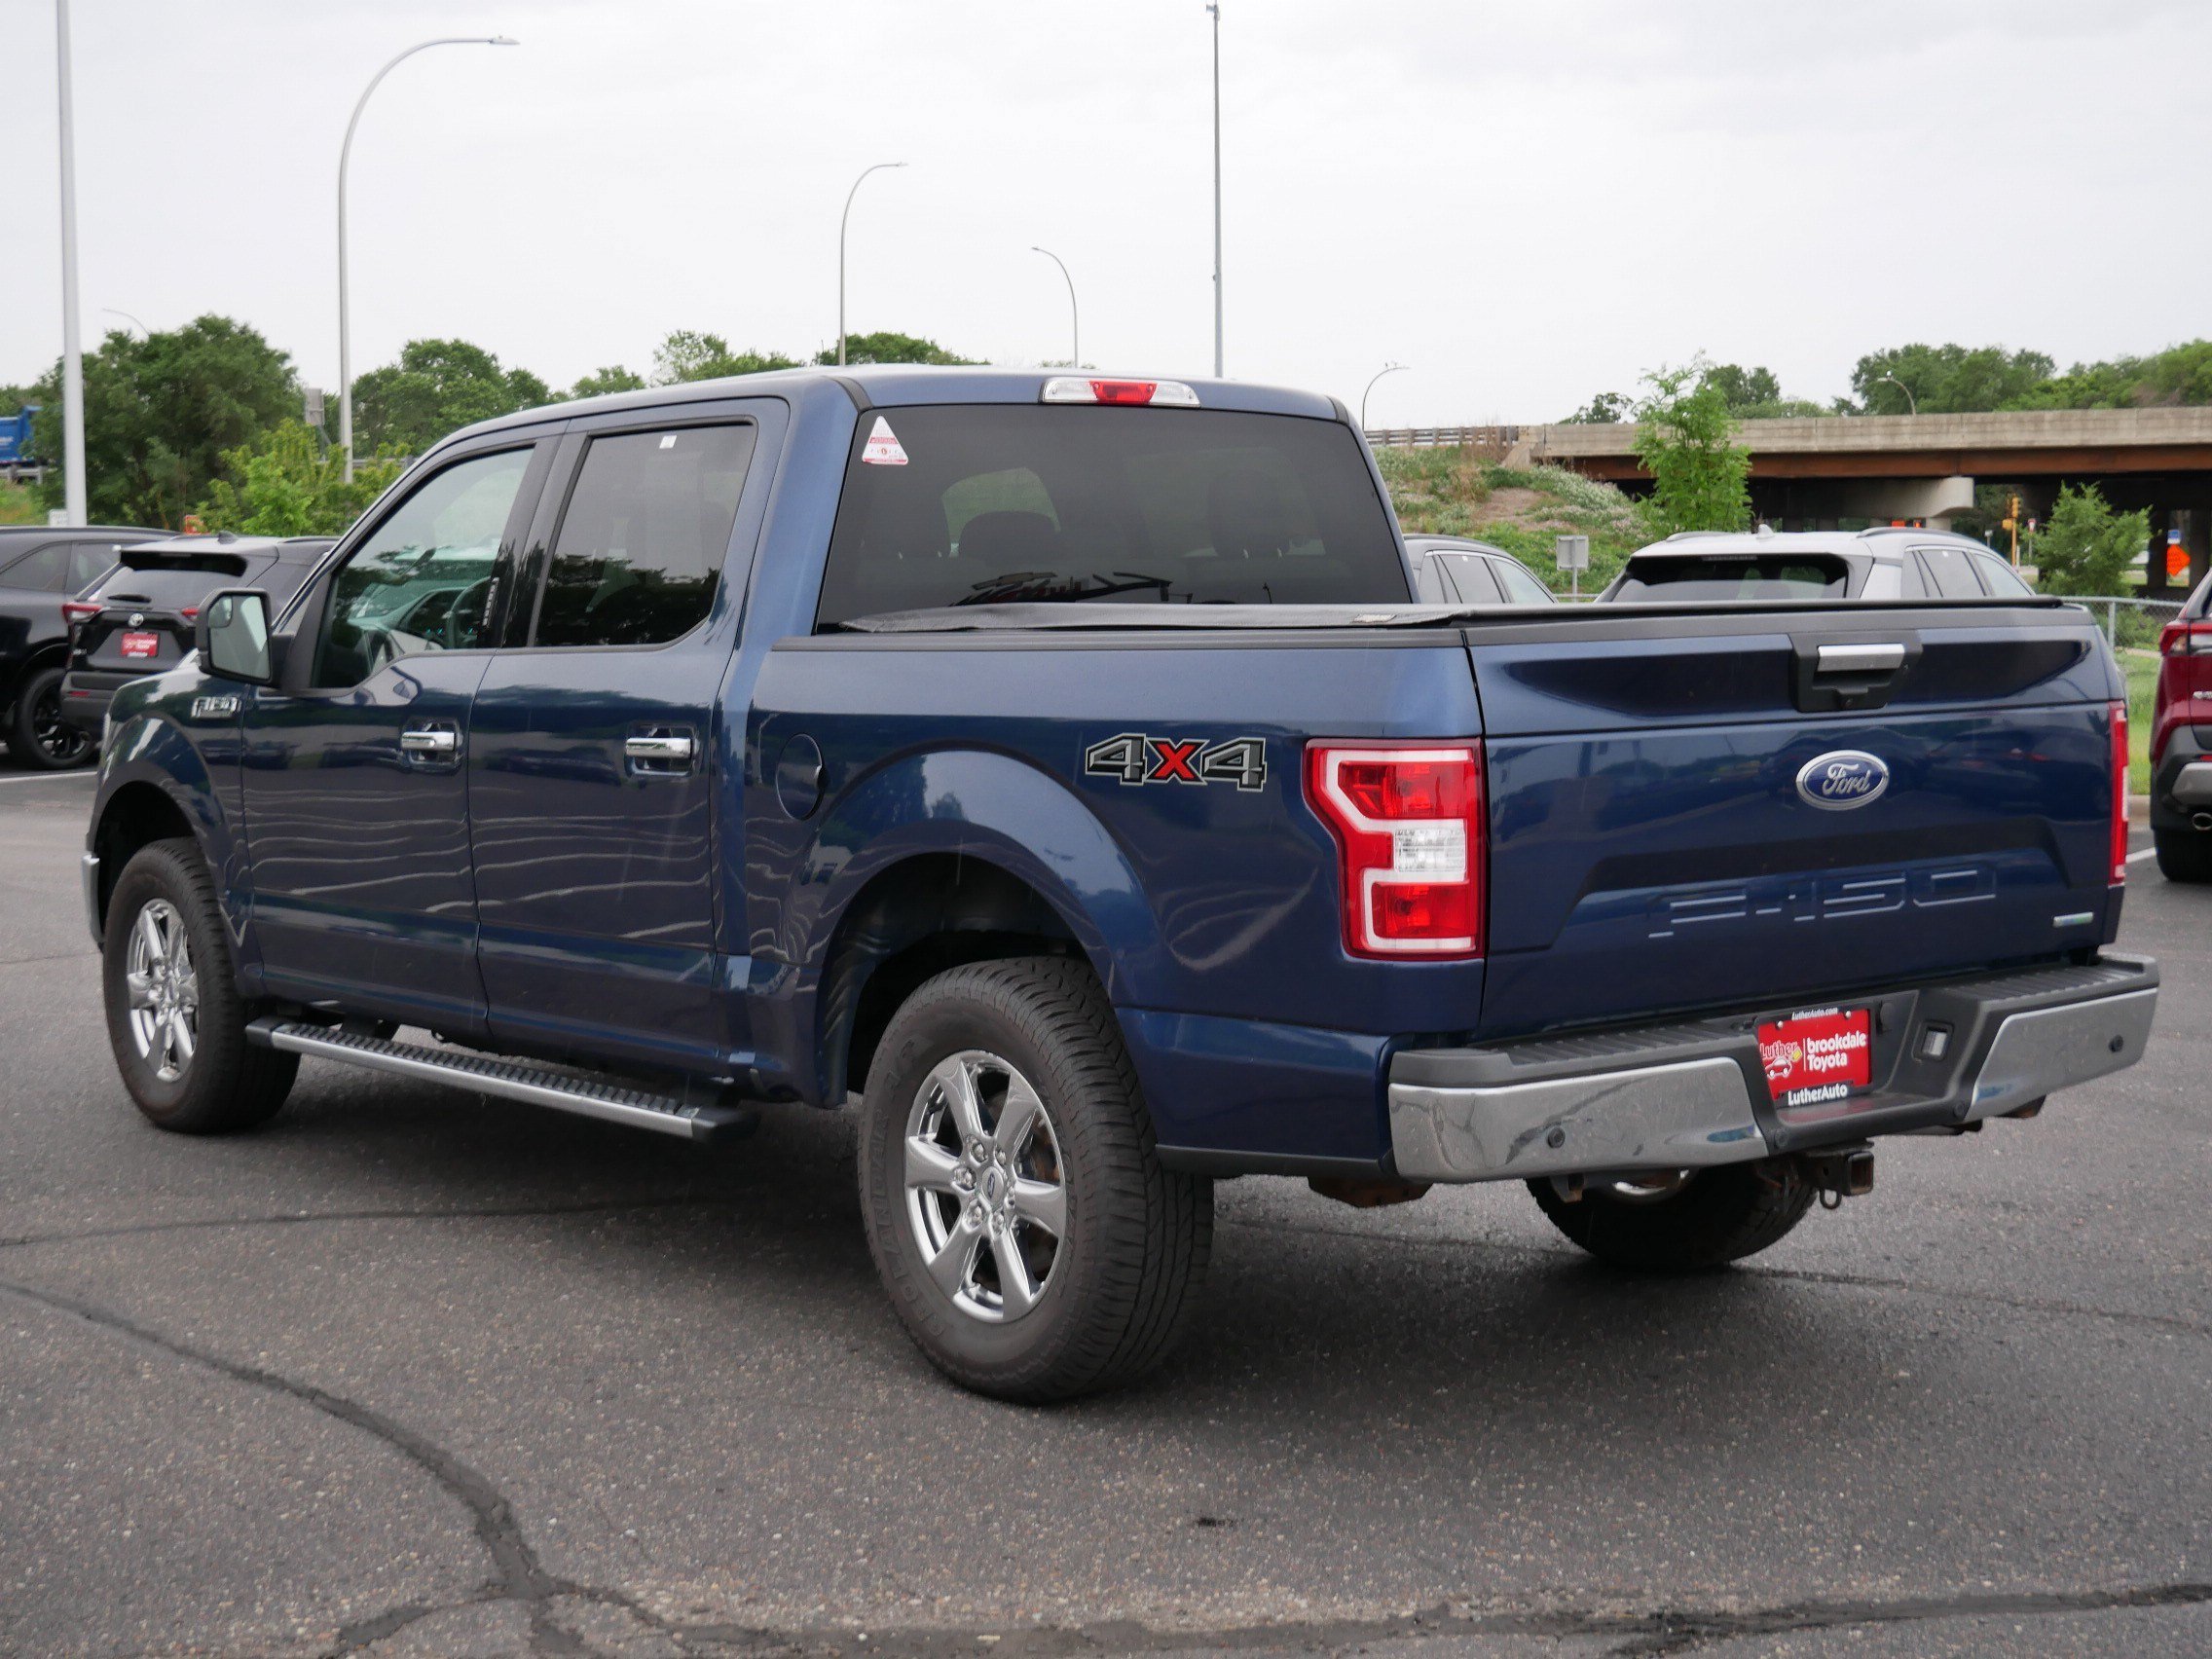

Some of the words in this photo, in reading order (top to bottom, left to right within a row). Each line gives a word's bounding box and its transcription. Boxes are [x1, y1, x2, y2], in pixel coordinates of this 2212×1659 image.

[1822, 763, 1871, 795] Ford
[1759, 1039, 1799, 1060] Luther
[1807, 1051, 1848, 1073] Toyota
[1788, 1083, 1848, 1106] LutherAuto
